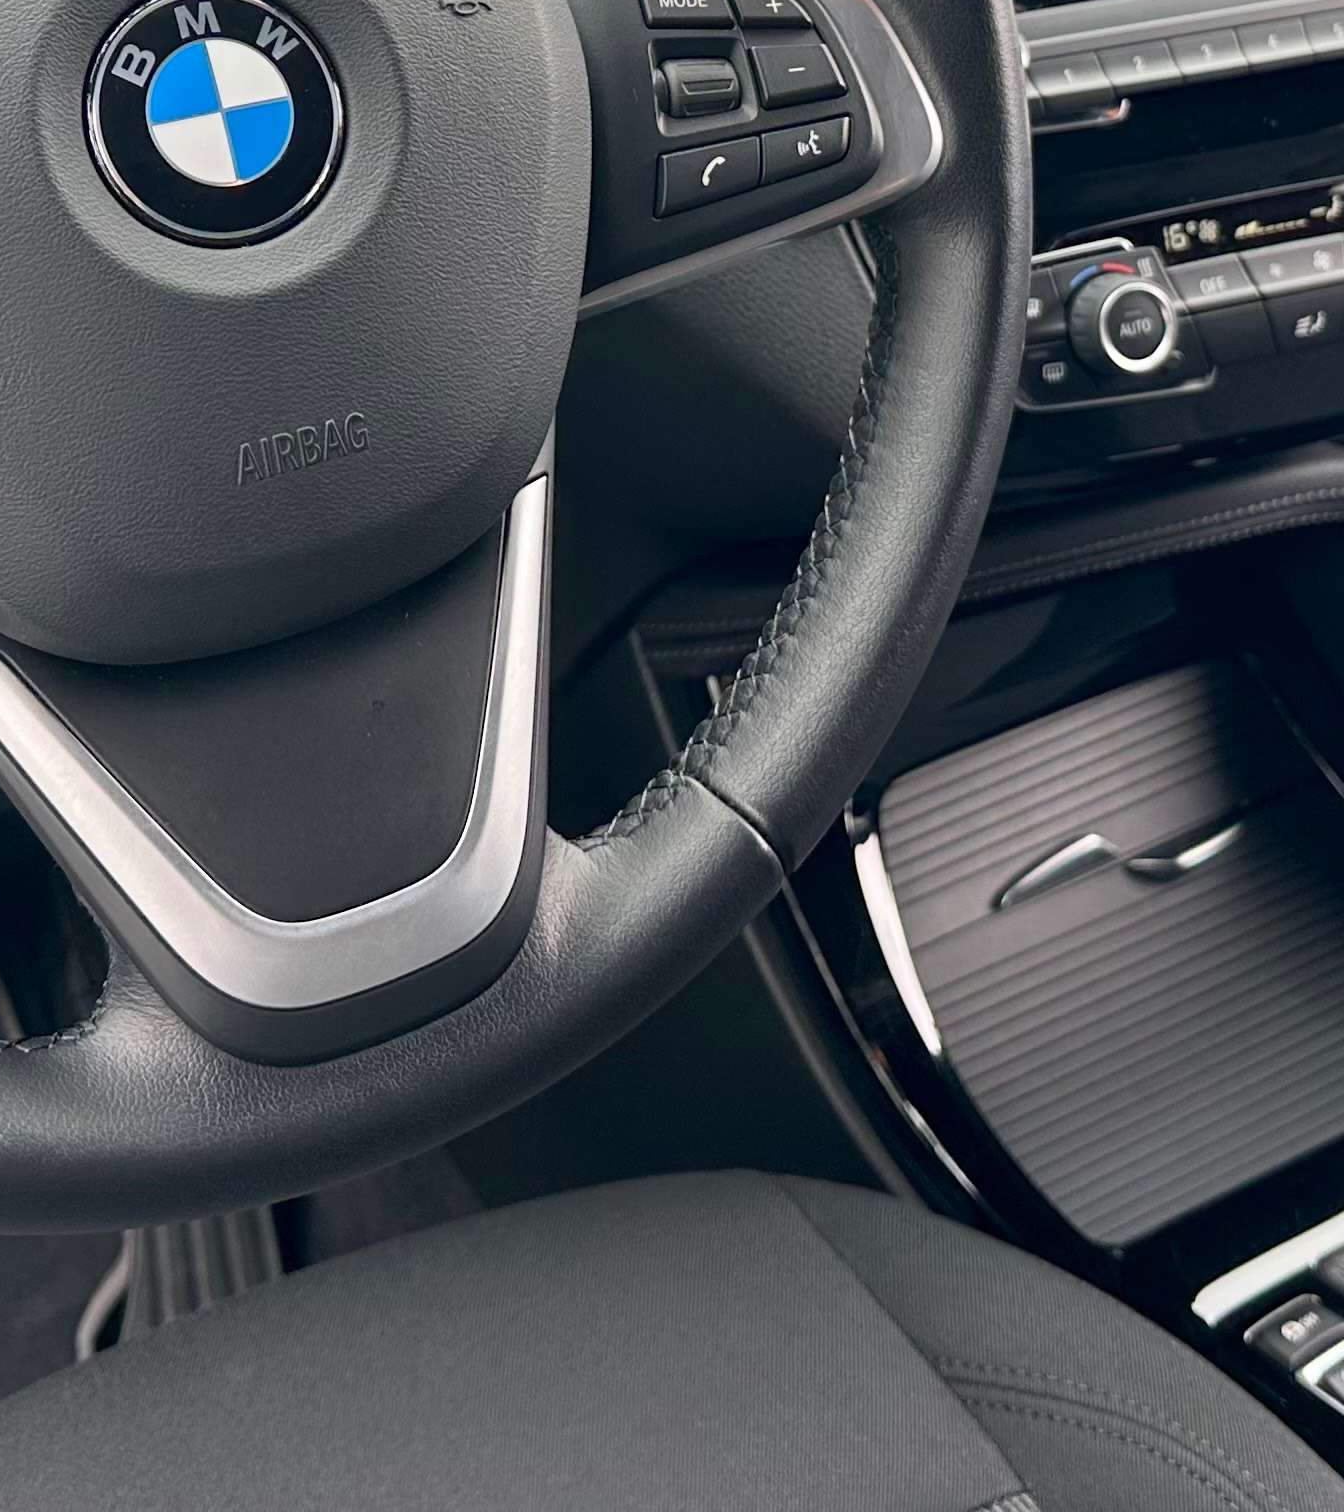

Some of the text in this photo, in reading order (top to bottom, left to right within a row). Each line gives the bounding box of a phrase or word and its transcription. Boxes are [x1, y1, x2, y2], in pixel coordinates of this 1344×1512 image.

[111, 1, 300, 88] BMW
[1132, 54, 1147, 73] 2
[1199, 274, 1227, 296] OFF
[1119, 317, 1152, 337] AUTO
[237, 411, 370, 486] AIRBAG
